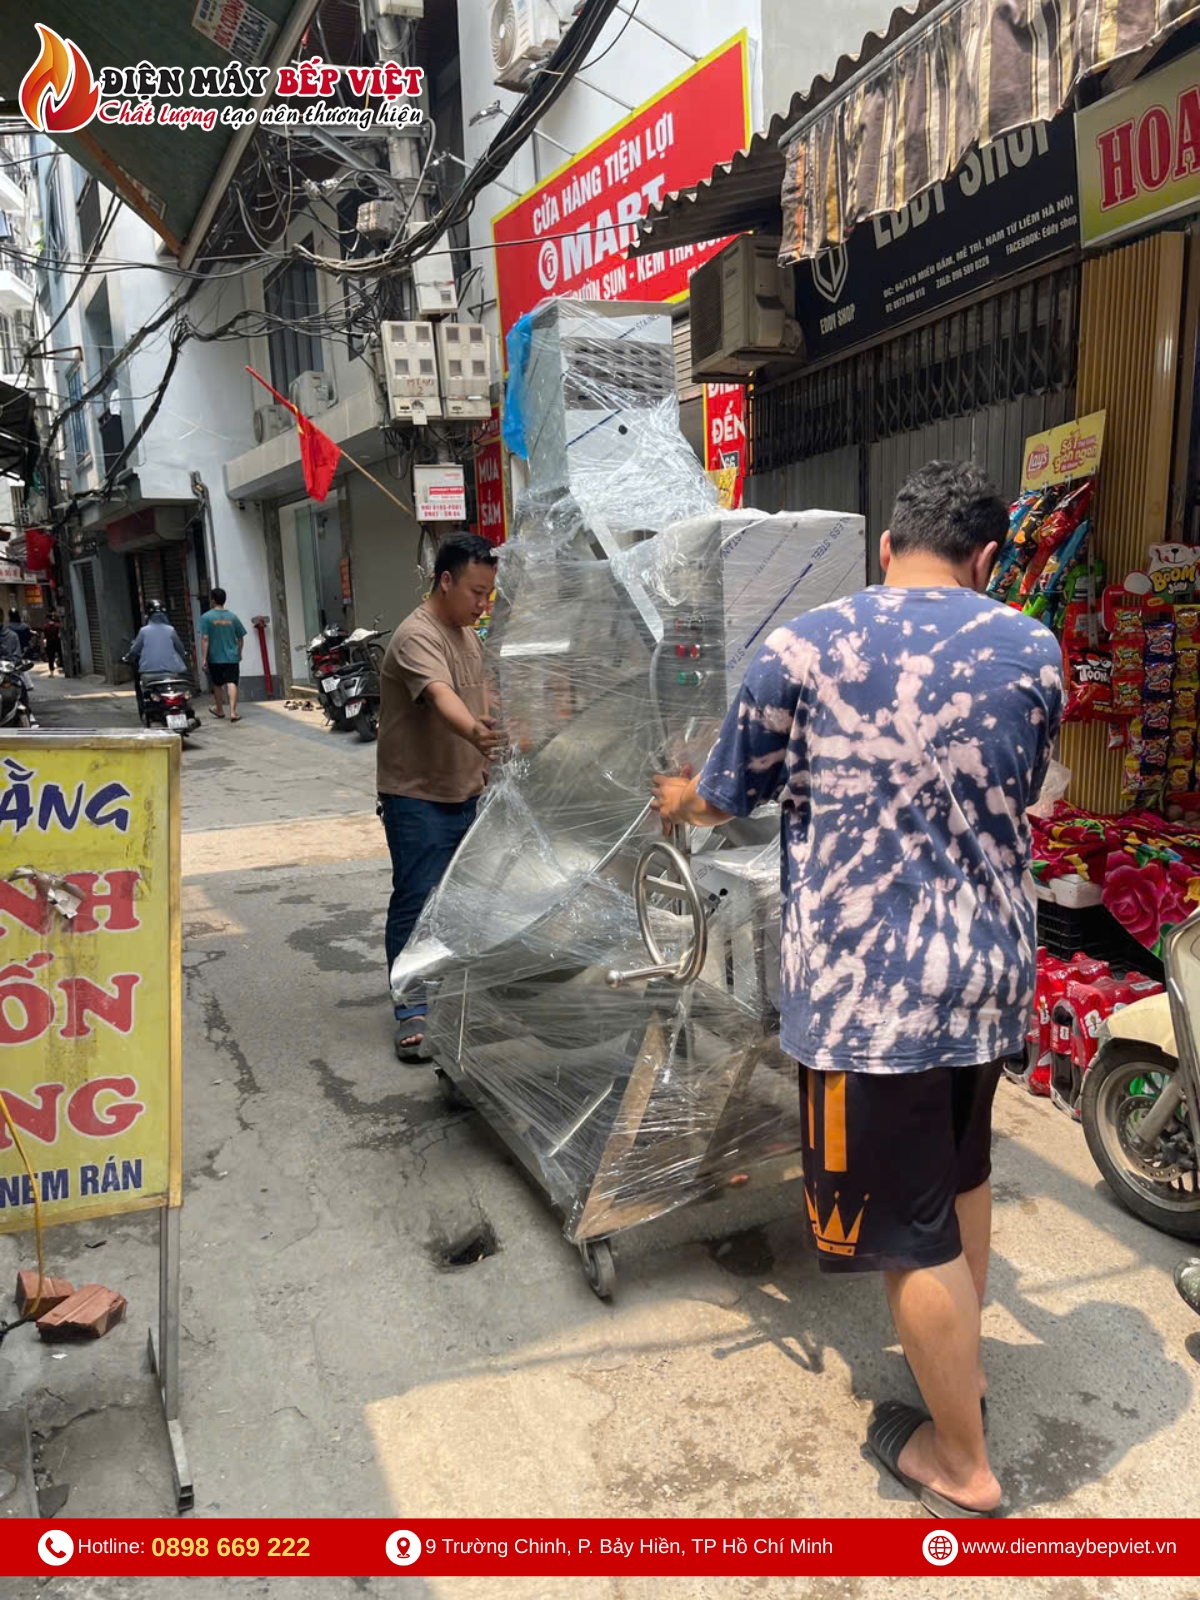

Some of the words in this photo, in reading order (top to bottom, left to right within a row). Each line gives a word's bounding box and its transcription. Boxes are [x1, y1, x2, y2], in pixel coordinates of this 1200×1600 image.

[1096, 83, 1200, 212] HOA
[533, 197, 560, 235] CỬA
[562, 169, 602, 217] HÀNG
[604, 140, 643, 183] TIỆN
[645, 112, 675, 159] LỢI
[561, 174, 666, 281] MART
[985, 229, 1005, 247] NAM
[1056, 194, 1074, 212] NỘI
[1005, 231, 1042, 256] FACEBOOK:
[1041, 222, 1060, 239] Eddy
[1059, 214, 1078, 231] shop
[636, 250, 666, 283] KEM
[819, 312, 837, 335] EDDY
[837, 304, 856, 330] SHOP
[478, 457, 500, 484] MUA
[1151, 565, 1196, 592] BOOM
[80, 1156, 143, 1197] RÁN
